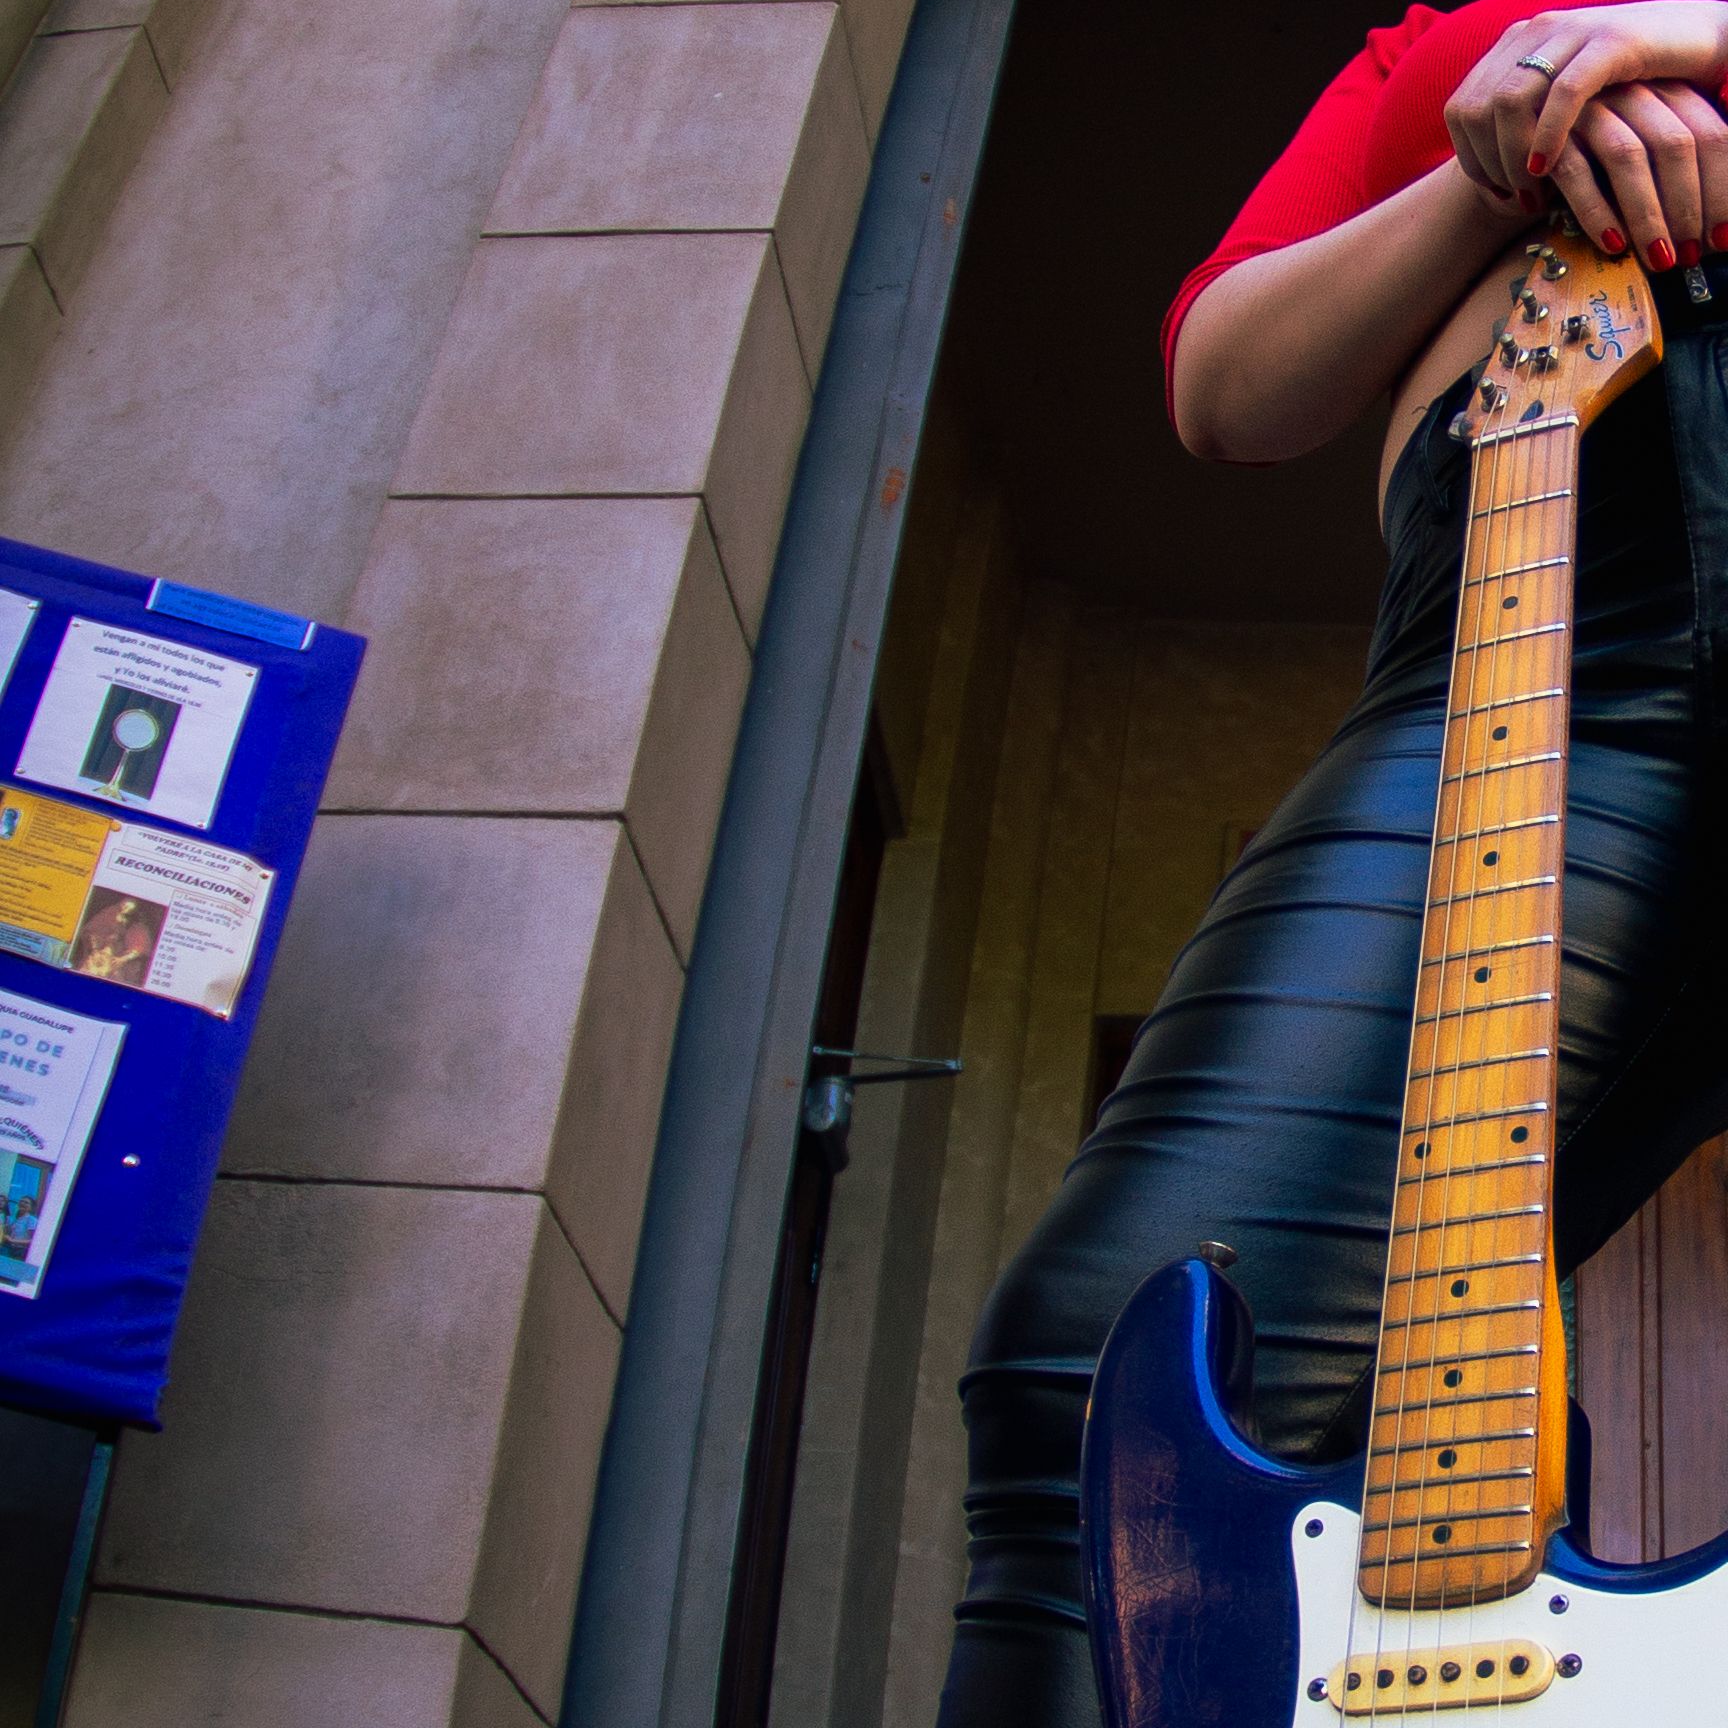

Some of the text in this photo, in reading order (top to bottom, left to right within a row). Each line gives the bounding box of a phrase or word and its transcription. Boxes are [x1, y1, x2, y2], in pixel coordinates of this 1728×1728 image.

[1584, 289, 1631, 361] Squier
[161, 645, 188, 661] todos
[191, 653, 205, 665] los
[114, 855, 251, 905] RECONCILIACIONES
[36, 1040, 65, 1058] DE
